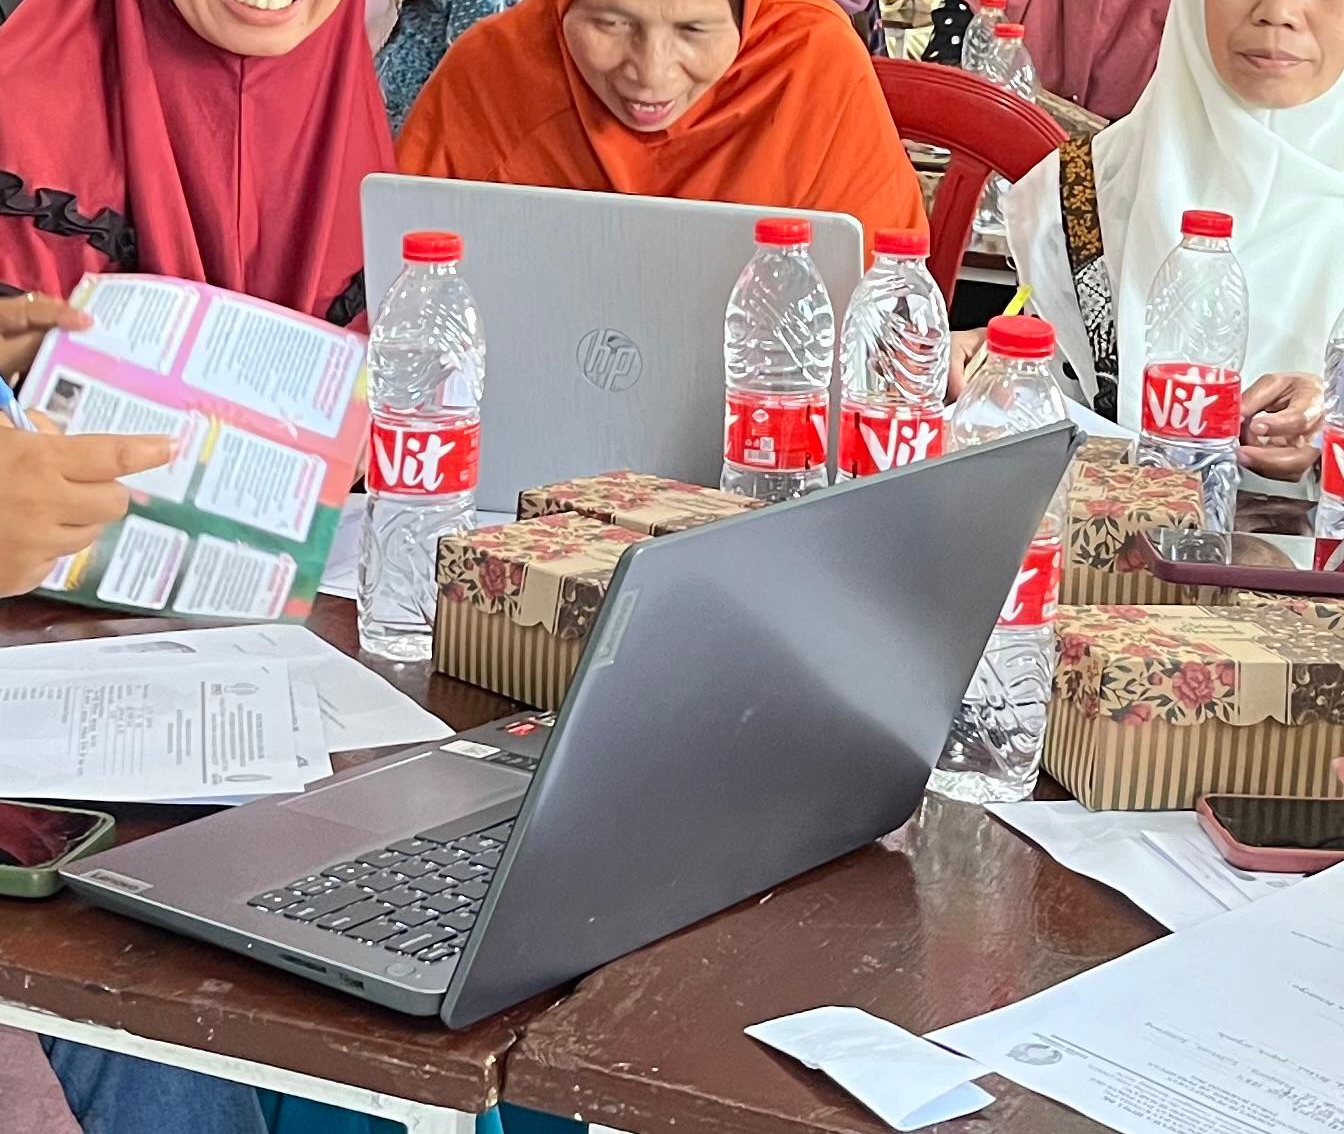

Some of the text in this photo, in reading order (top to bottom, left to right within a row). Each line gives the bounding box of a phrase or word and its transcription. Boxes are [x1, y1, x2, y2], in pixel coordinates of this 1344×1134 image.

[583, 328, 638, 391] hp
[1145, 378, 1219, 436] Vit
[372, 427, 456, 492] Vit
[859, 418, 939, 472] Vit
